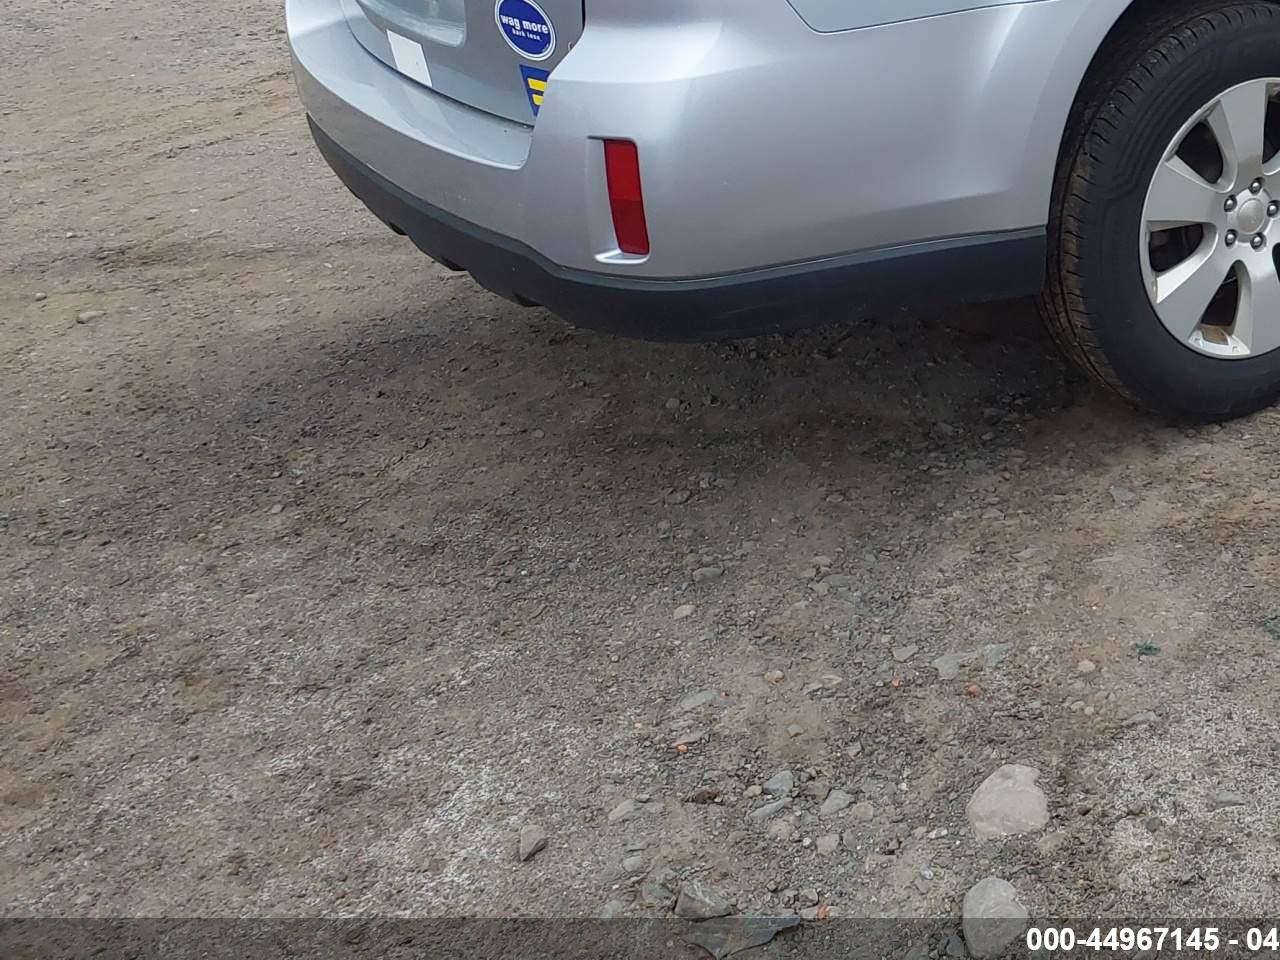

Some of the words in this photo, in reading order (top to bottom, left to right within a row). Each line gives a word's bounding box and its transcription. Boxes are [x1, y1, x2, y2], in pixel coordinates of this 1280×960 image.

[500, 14, 521, 30] wag
[521, 20, 549, 34] more
[512, 28, 526, 37] bark
